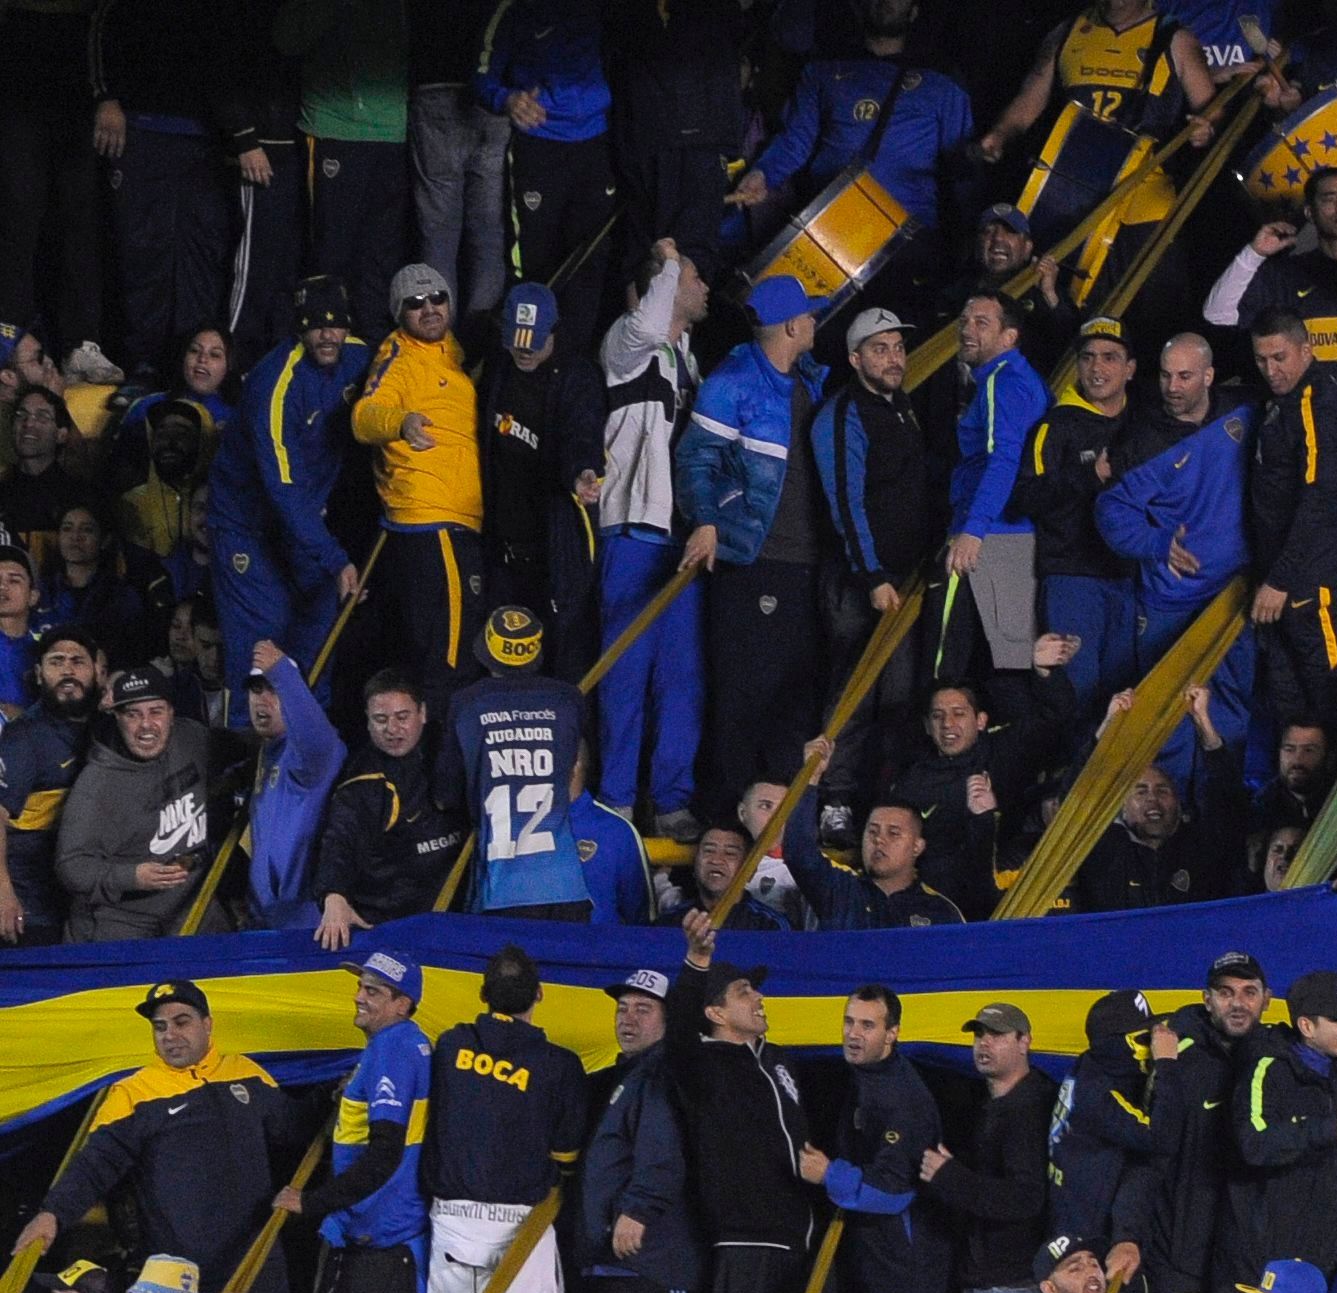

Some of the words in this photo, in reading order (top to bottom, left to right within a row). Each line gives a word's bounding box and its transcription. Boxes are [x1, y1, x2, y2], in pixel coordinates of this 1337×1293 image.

[502, 640, 543, 658] BOC
[485, 727, 554, 744] JUGADOR
[488, 748, 554, 778] NRO
[484, 782, 556, 862] 12
[455, 1047, 531, 1093] BOCA
